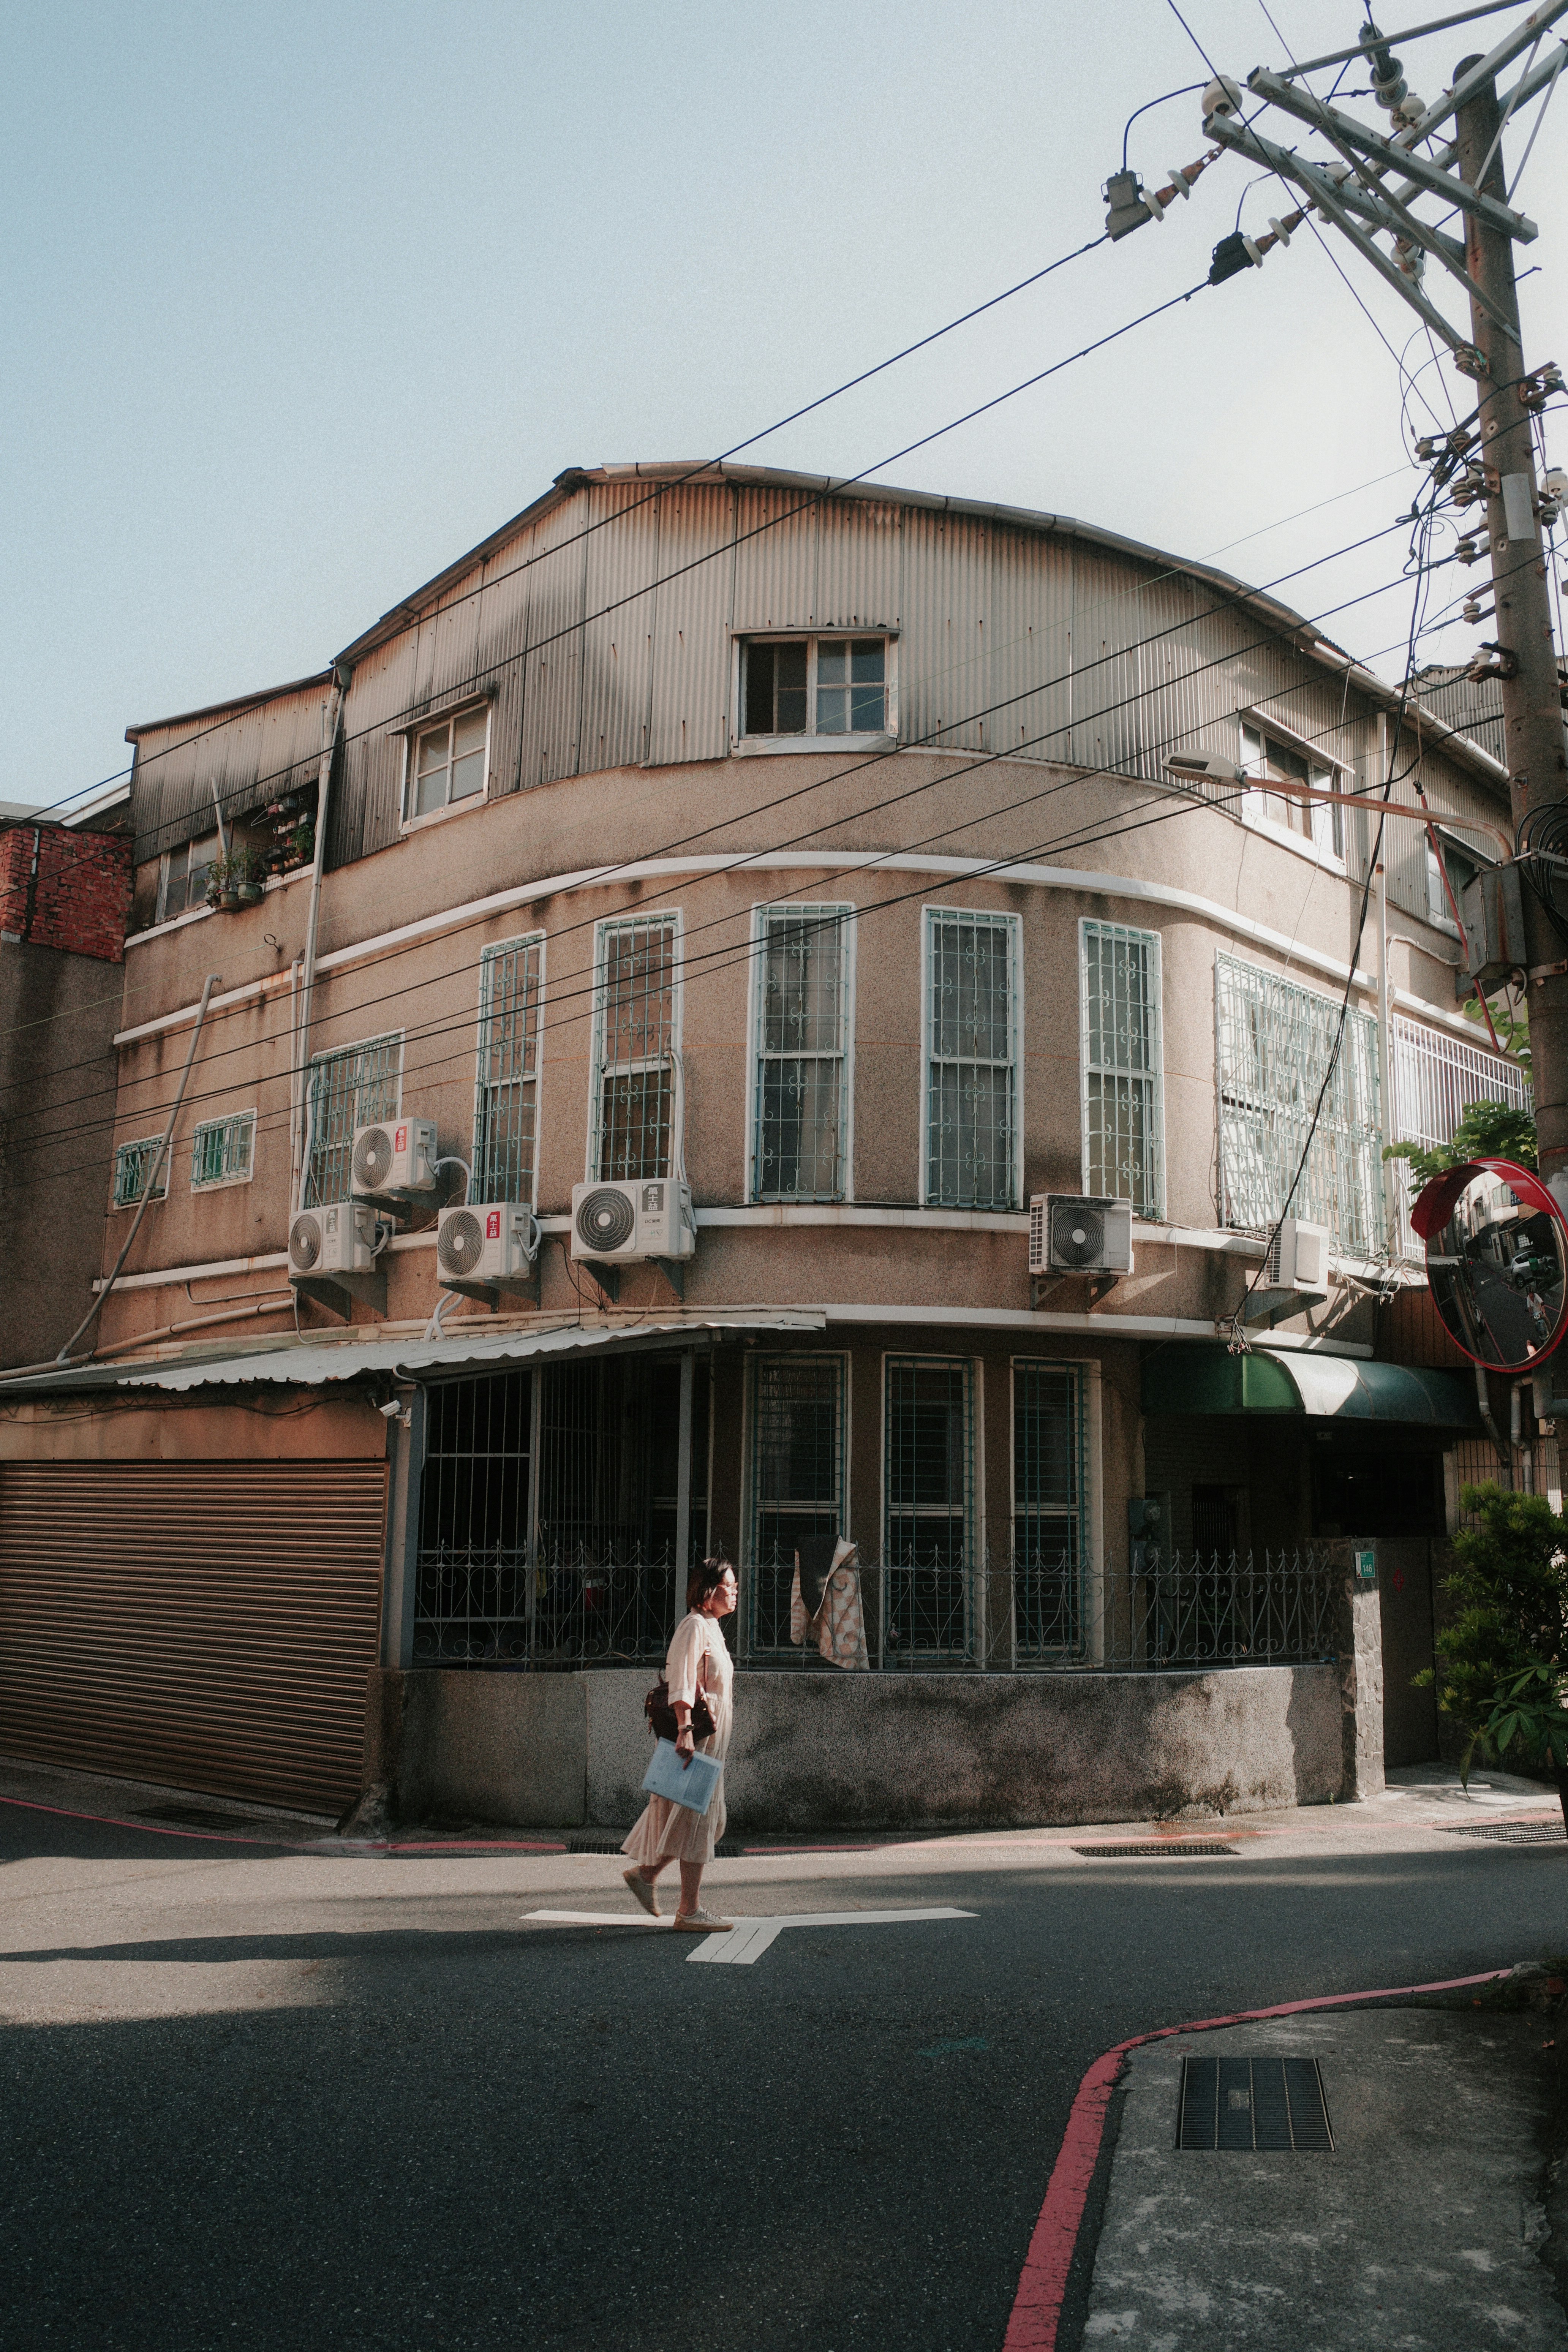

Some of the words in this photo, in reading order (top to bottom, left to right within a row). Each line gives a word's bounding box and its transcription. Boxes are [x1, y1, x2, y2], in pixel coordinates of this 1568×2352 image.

[648, 1187, 658, 1211] 萬士益
[1363, 1564, 1372, 1573] 146
